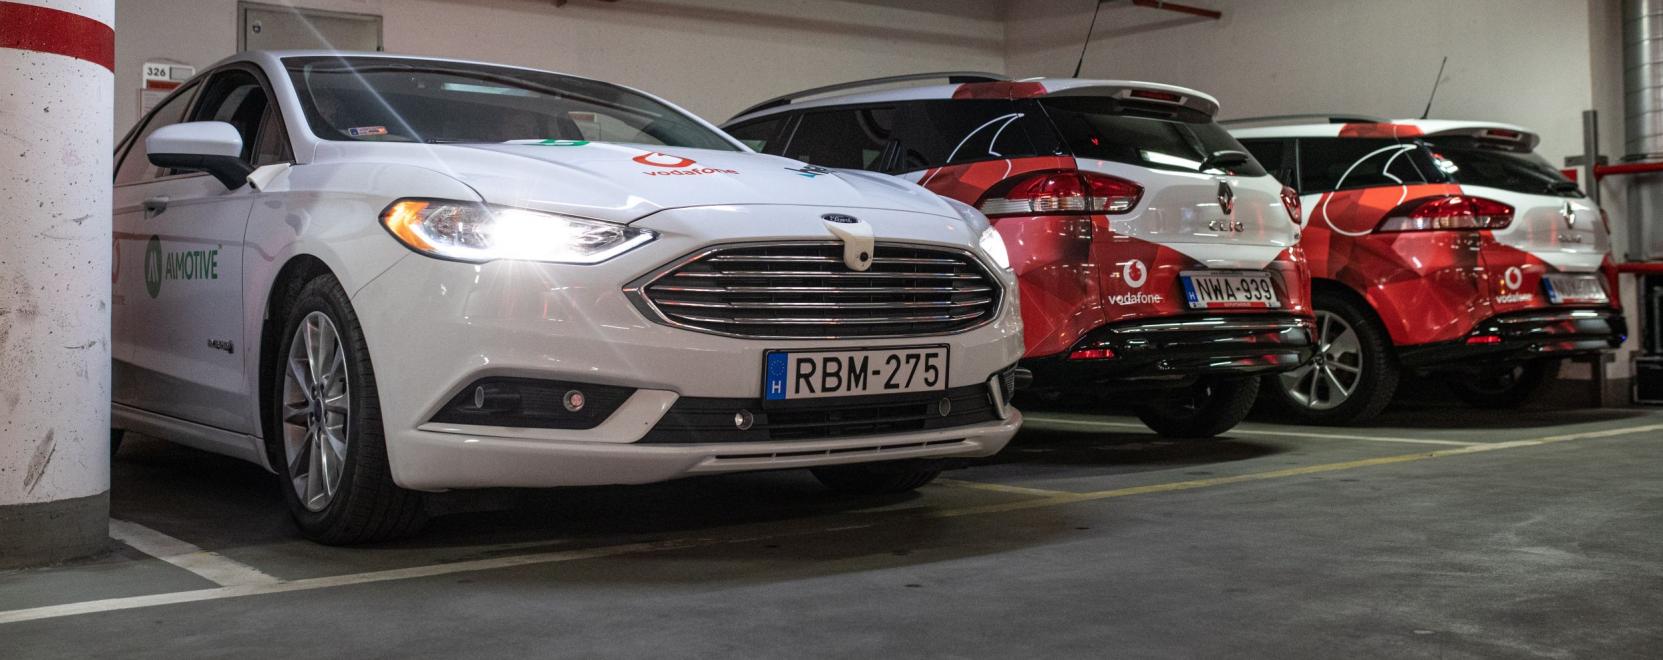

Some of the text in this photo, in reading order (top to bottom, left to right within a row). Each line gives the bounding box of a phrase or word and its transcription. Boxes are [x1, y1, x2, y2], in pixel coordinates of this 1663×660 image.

[147, 67, 166, 77] 326
[642, 167, 739, 176] vodafone
[1195, 278, 1273, 301] NWA-939
[1108, 292, 1161, 305] vodafone
[794, 352, 939, 394] RBM-275
[771, 381, 782, 394] H
